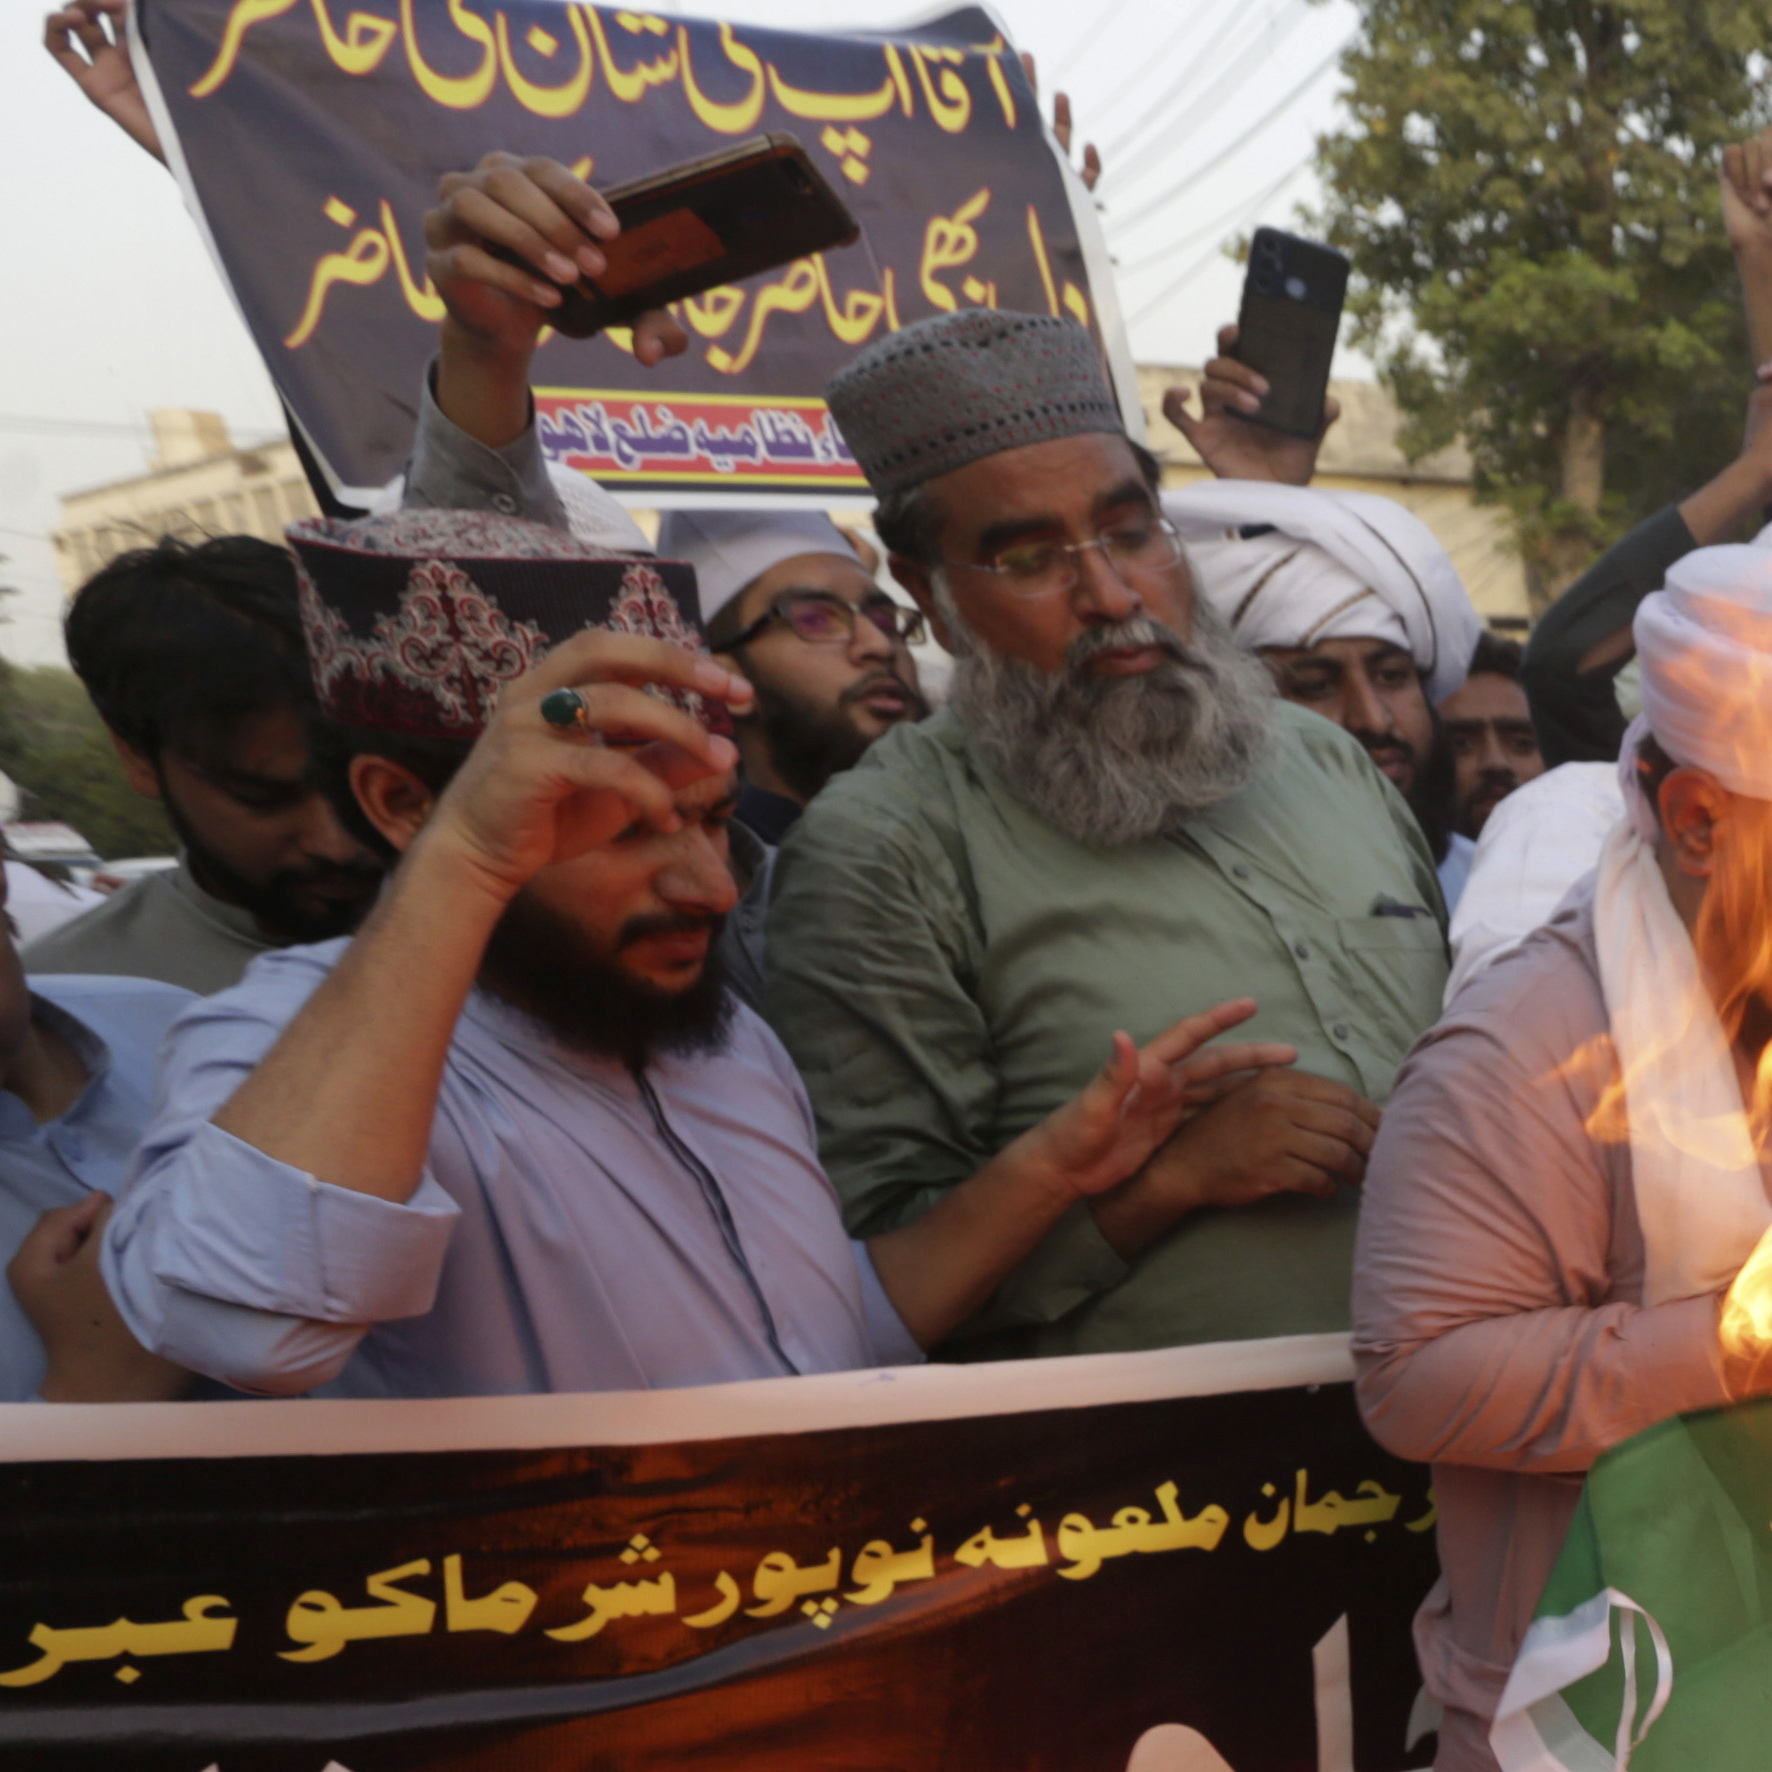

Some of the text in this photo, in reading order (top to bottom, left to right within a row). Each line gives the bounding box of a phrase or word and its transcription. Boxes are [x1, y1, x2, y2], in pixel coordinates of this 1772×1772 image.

[285, 195, 448, 350] اضر
[537, 399, 613, 467] لاہو
[1242, 1467, 1437, 1552] رجمان
[680, 1516, 936, 1630] نوپور
